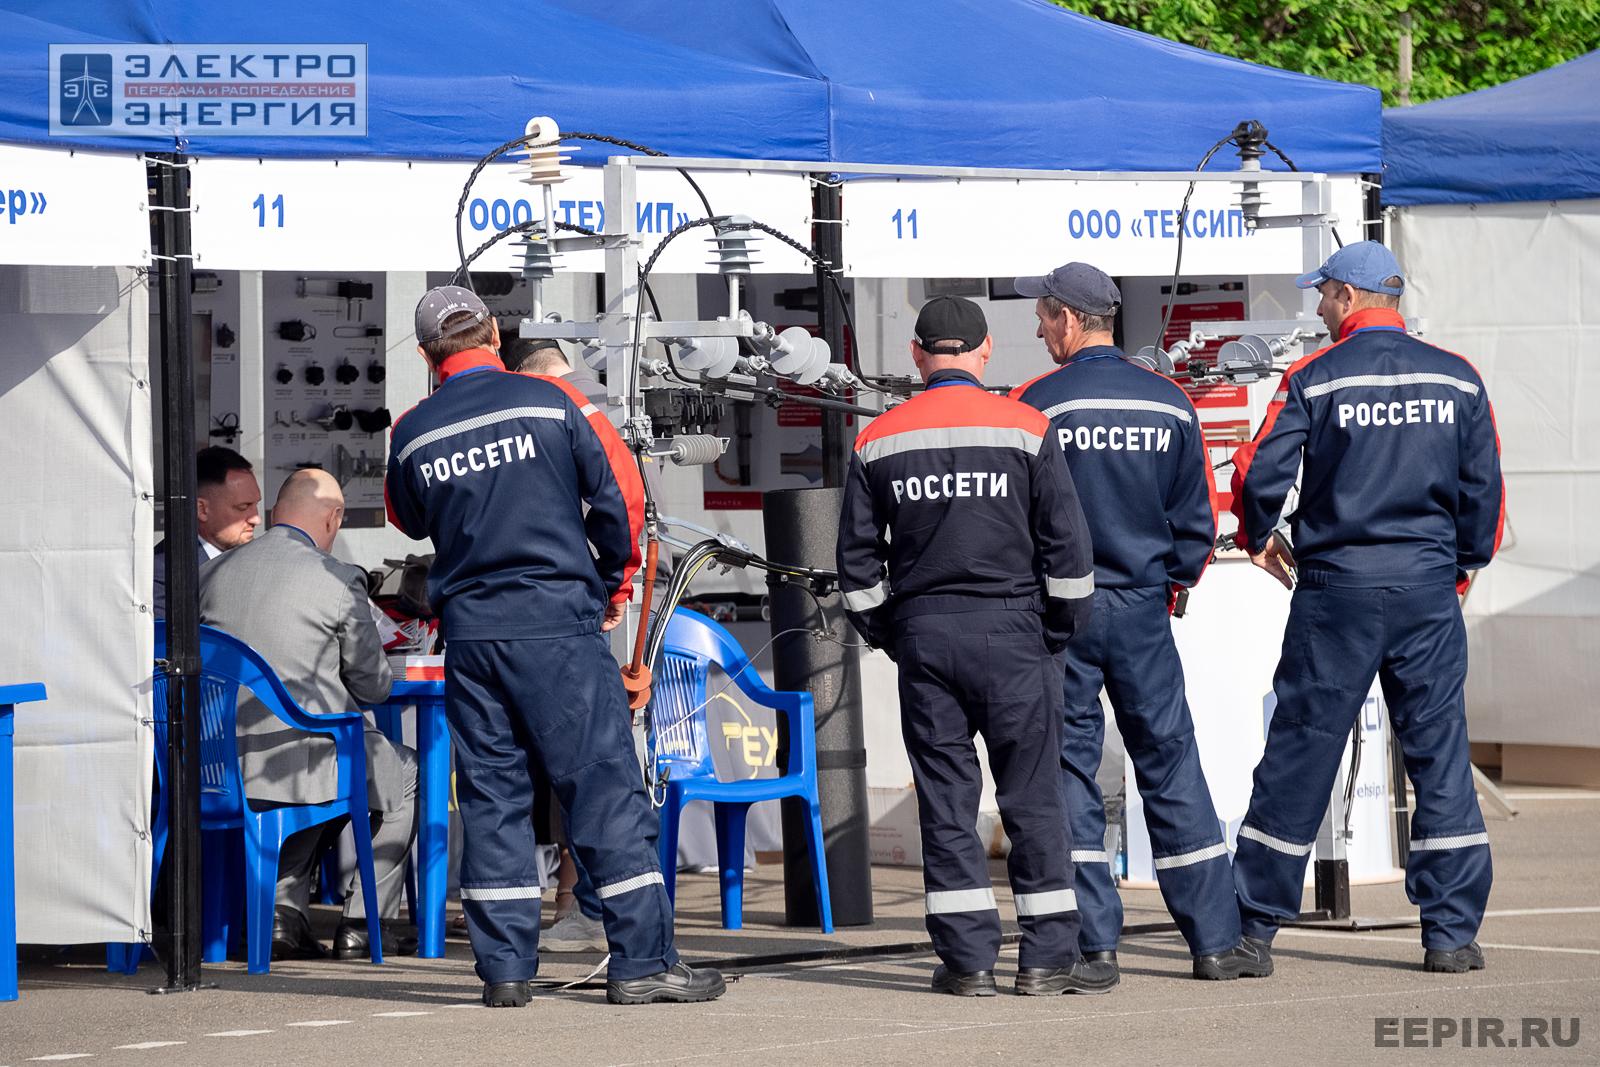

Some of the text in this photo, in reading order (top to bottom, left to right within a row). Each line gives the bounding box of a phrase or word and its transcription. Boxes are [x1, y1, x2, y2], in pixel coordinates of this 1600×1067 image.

[253, 194, 284, 227] 11
[469, 198, 532, 231] ООО
[892, 209, 918, 239] 11
[1069, 209, 1121, 239] ООО
[1339, 400, 1455, 428] РОССЕТИ
[1057, 426, 1172, 452] РОССЕТИ
[419, 433, 536, 488] РОССЕТИ
[891, 472, 1008, 504] РОССЕТИ
